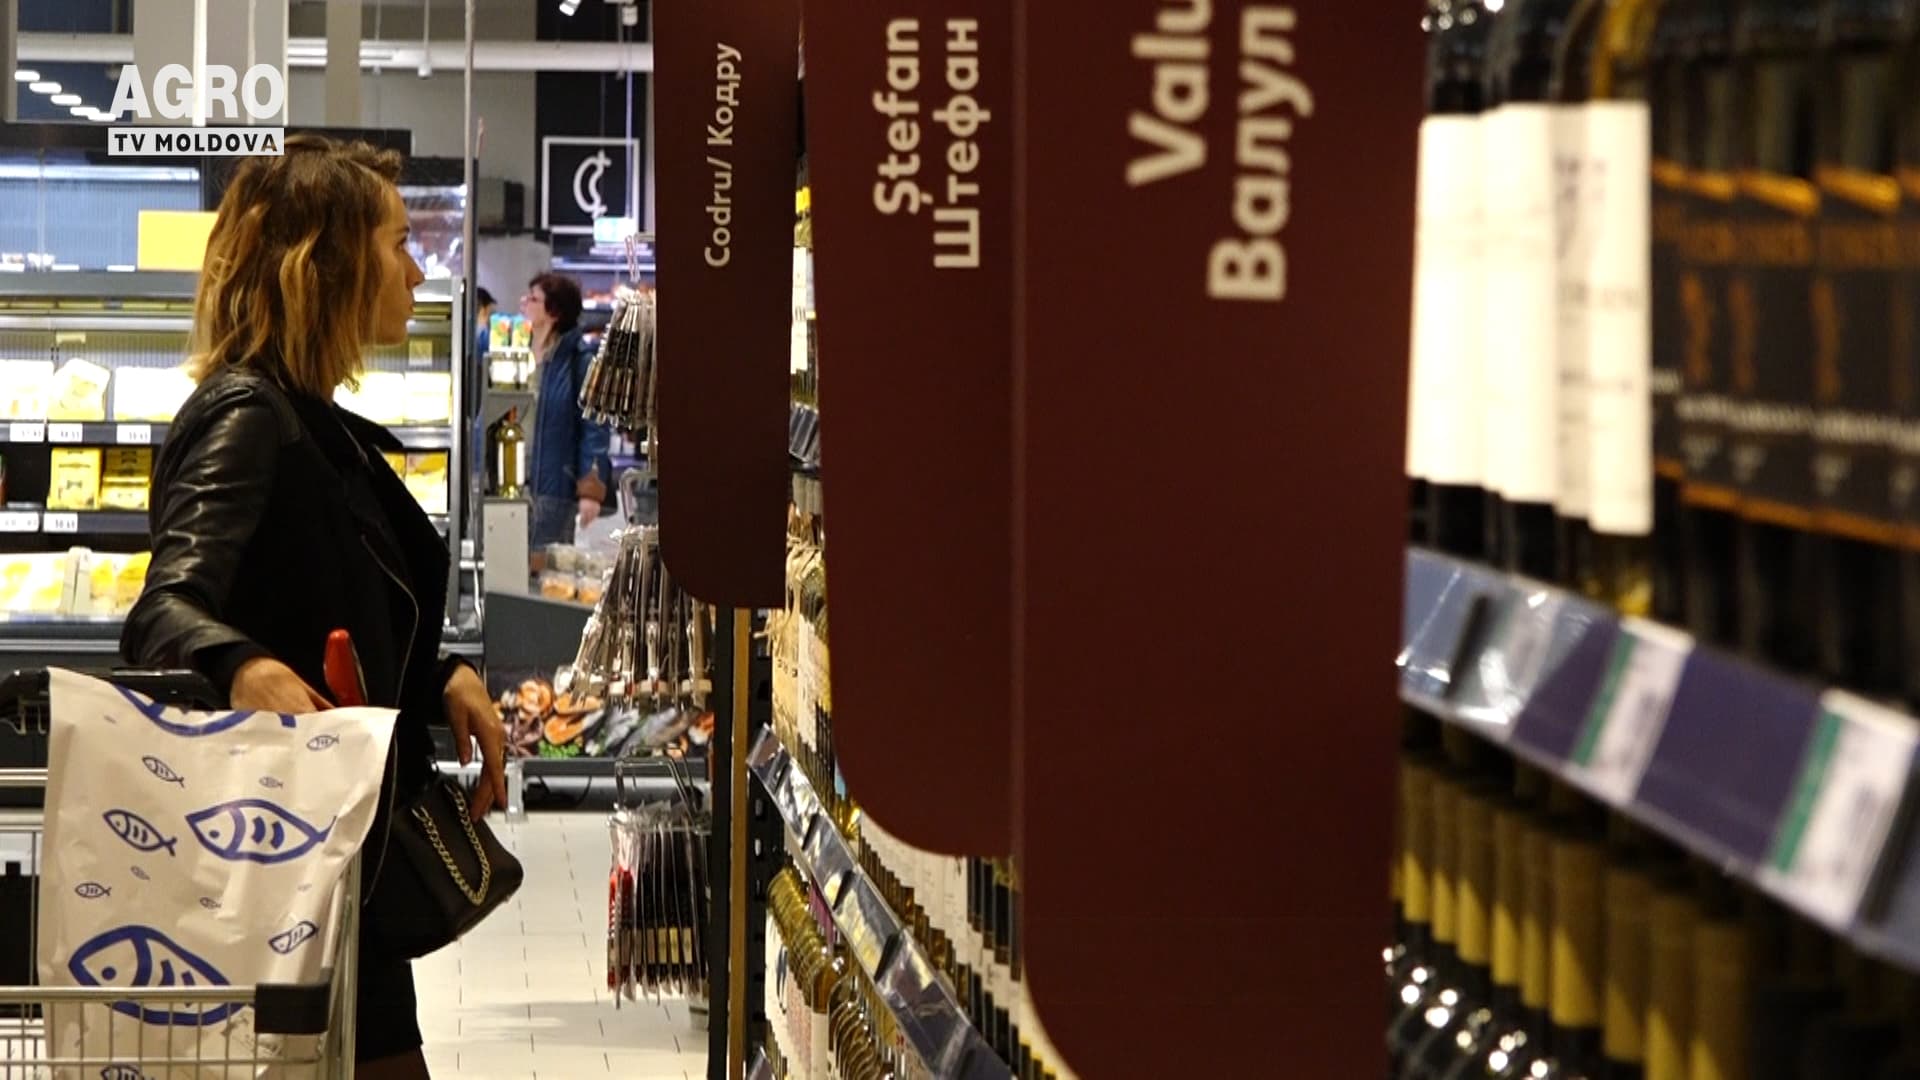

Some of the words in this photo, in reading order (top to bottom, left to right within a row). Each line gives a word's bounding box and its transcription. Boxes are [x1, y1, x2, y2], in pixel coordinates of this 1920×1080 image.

[706, 42, 742, 146] Кодру
[932, 18, 991, 268] Штефан
[1206, 6, 1315, 300] Валул
[704, 156, 733, 268] Codru/
